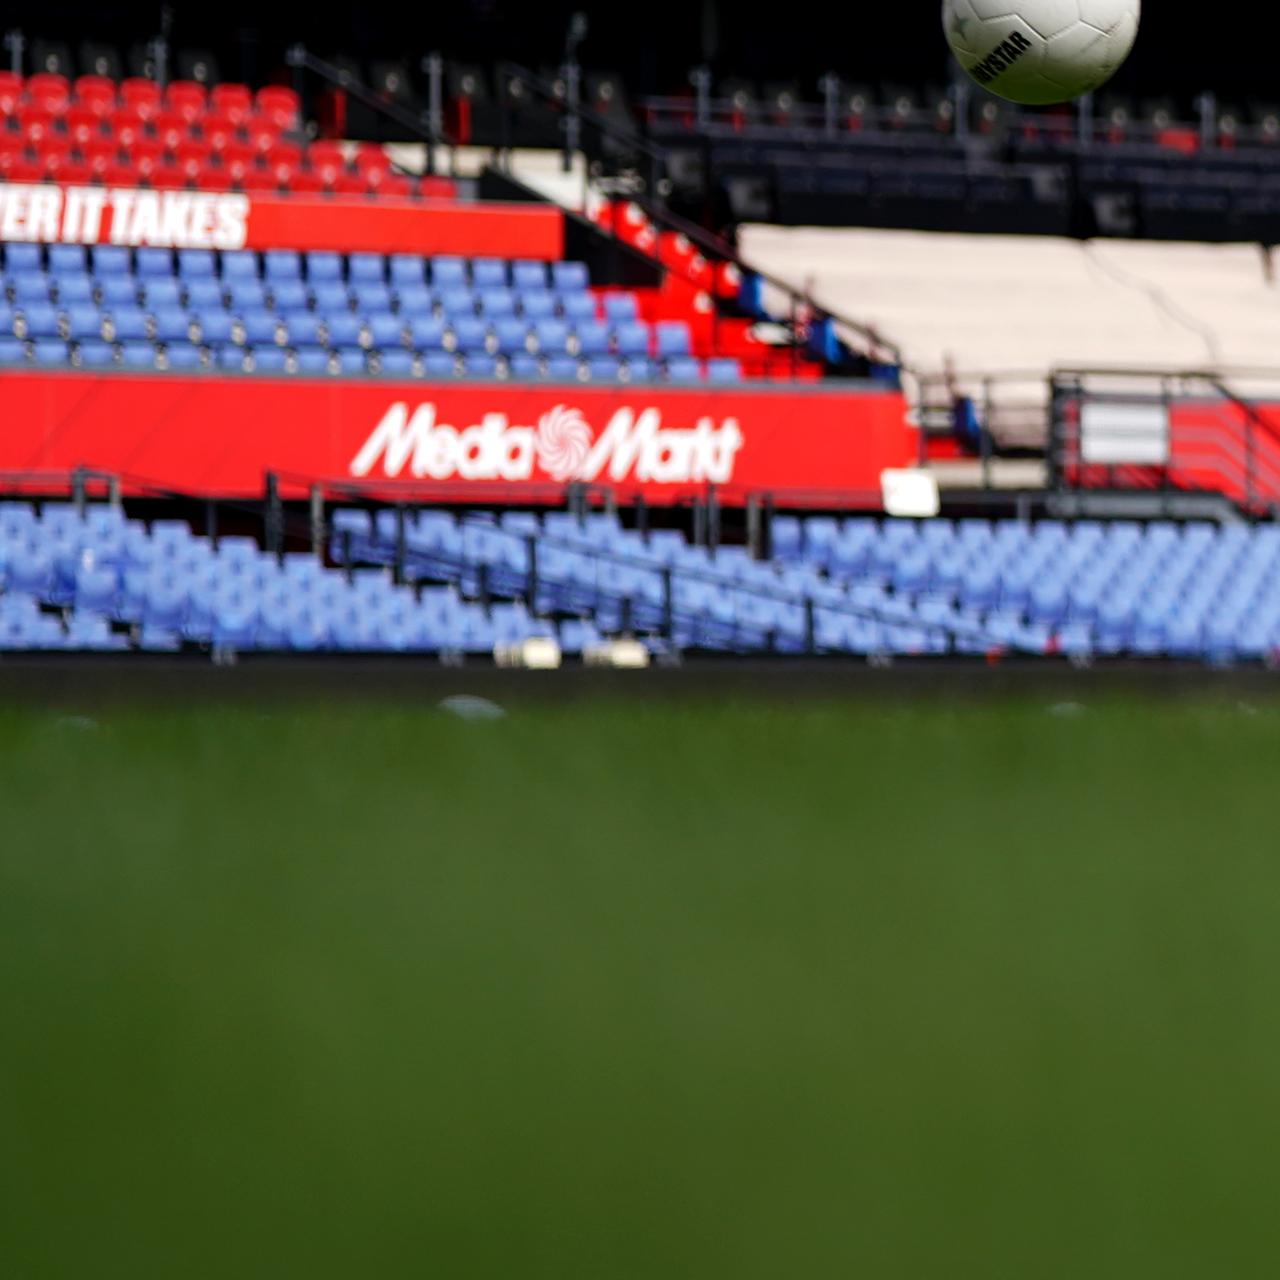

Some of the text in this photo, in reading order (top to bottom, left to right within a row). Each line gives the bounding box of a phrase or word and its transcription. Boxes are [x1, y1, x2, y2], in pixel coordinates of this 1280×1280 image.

[0, 182, 249, 251] ER IT TAKES
